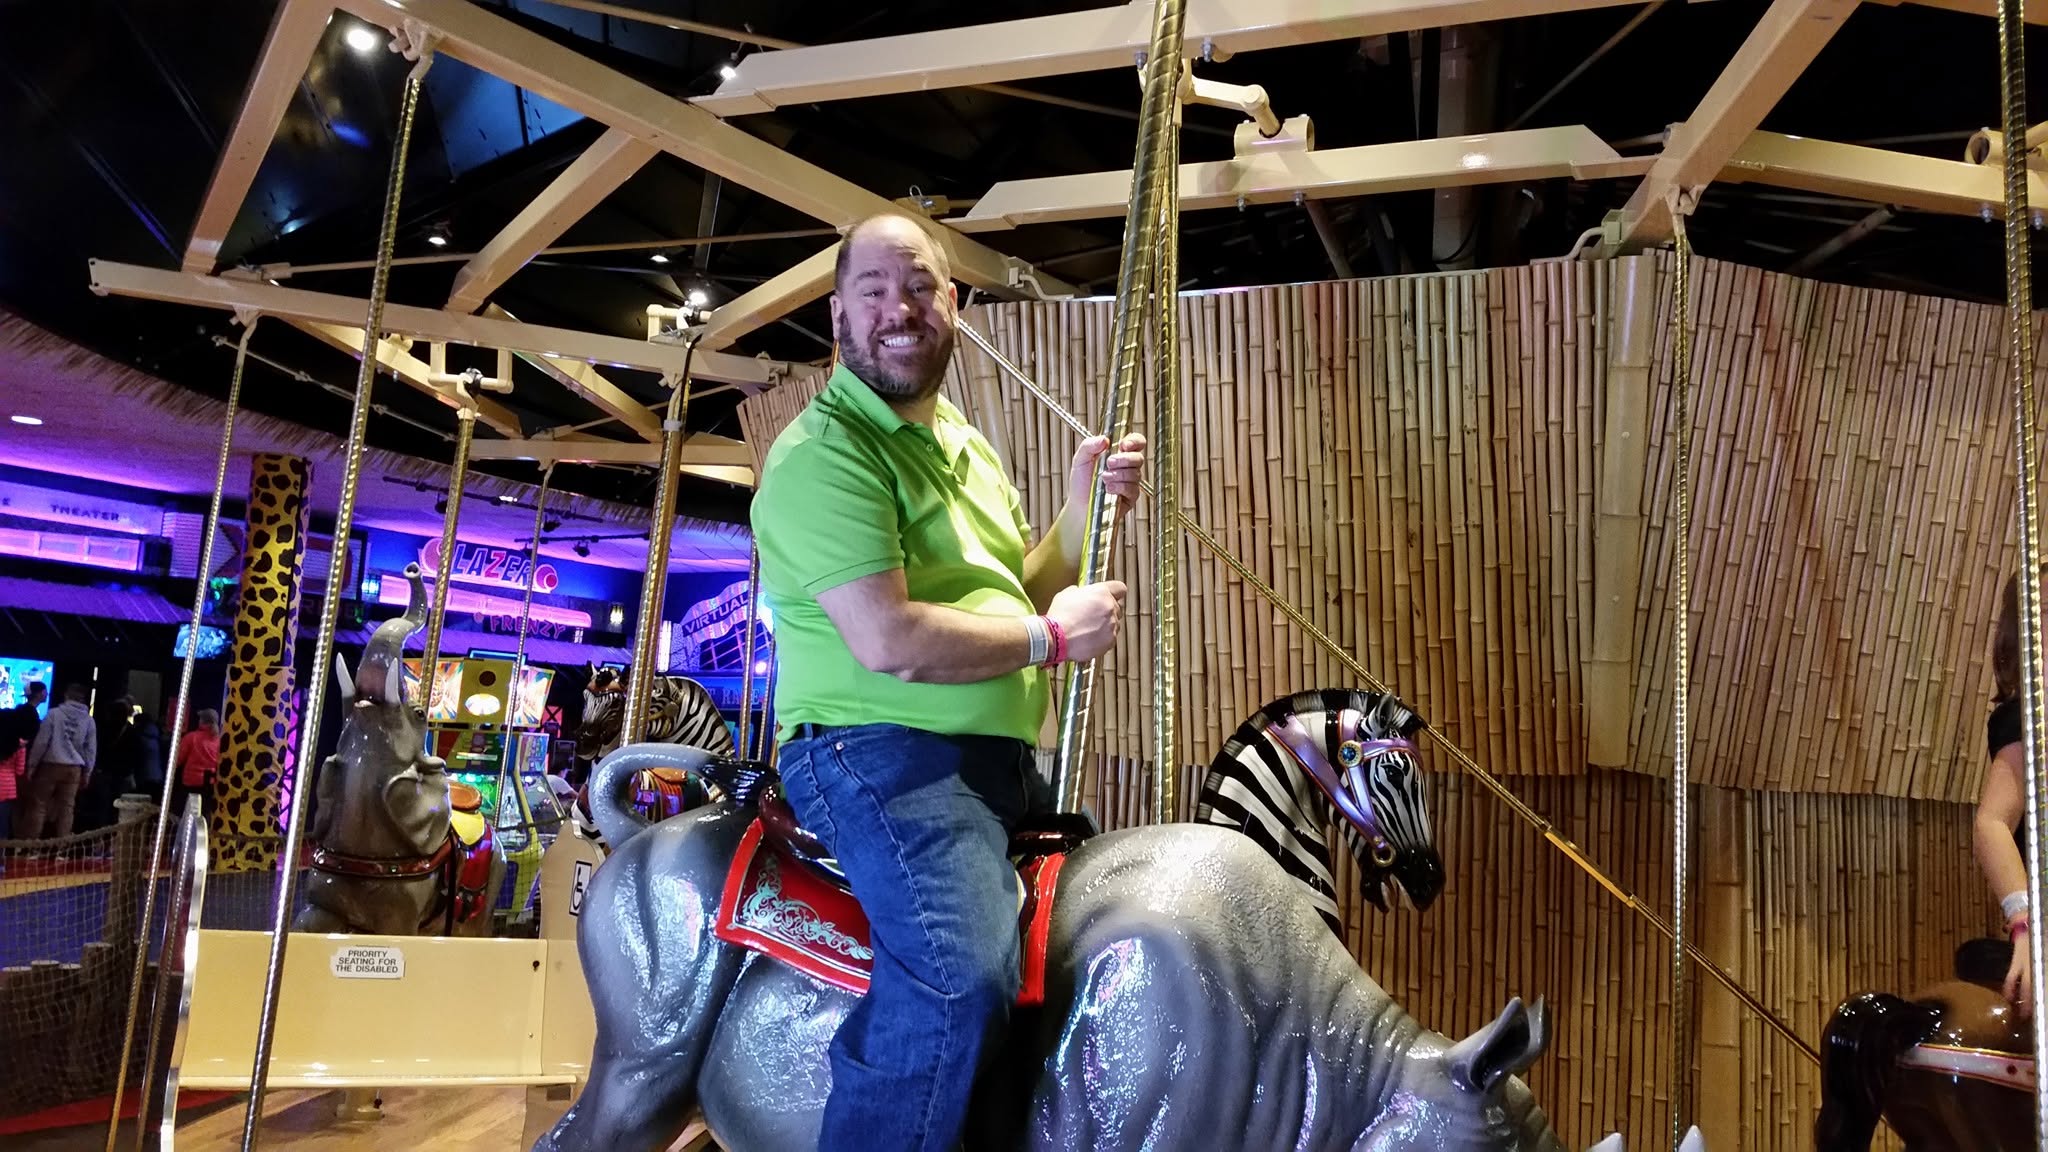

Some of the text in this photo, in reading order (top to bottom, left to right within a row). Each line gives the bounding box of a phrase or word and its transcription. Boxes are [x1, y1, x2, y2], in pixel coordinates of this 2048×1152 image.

[51, 504, 120, 521] THEATER
[450, 543, 536, 586] LAZER
[685, 593, 749, 634] VIRTUAL
[490, 614, 566, 639] FRENZY
[338, 957, 396, 966] SEATING FOR
[348, 950, 388, 958] PRIORITY
[335, 964, 398, 974] THE DISABLED
